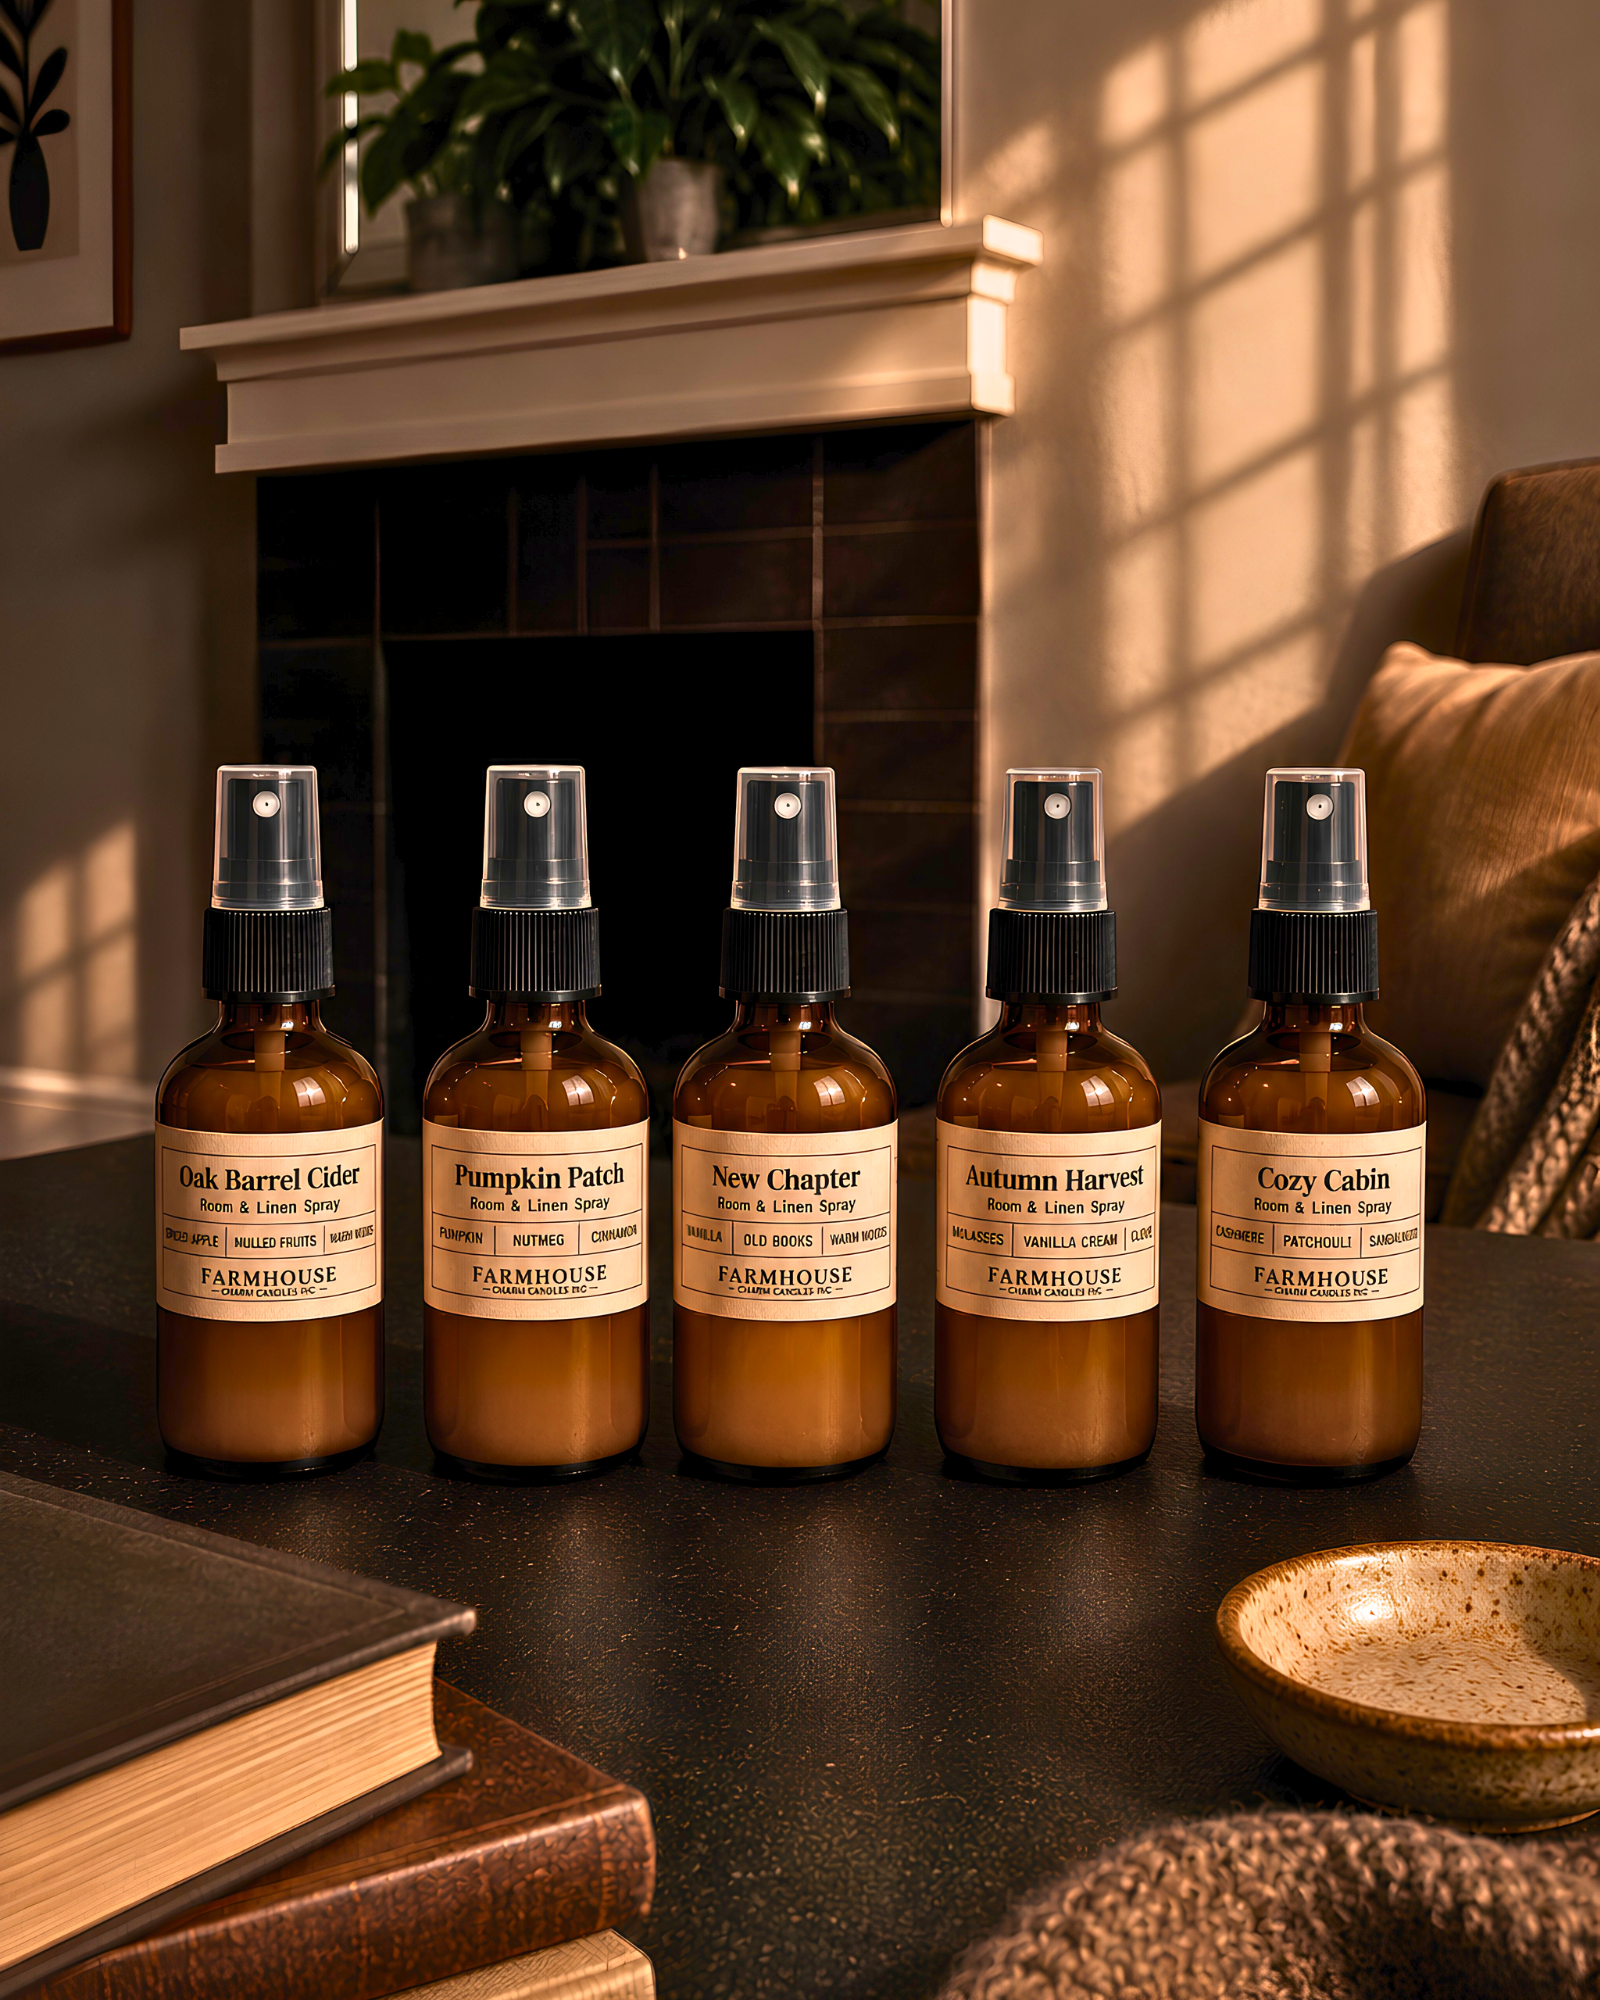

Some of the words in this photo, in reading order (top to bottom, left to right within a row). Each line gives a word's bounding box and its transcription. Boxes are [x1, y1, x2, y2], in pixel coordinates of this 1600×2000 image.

[180, 1165, 219, 1190] Oak
[225, 1168, 301, 1191] Barrel
[308, 1165, 360, 1189] Cider
[455, 1164, 561, 1195] Pumpkin
[568, 1162, 624, 1188] Patch
[713, 1165, 760, 1189] New
[767, 1169, 860, 1195] Chapter
[966, 1165, 1058, 1191] Autumn
[1065, 1165, 1143, 1191] Harvest
[1257, 1167, 1317, 1197] Cozy
[1324, 1168, 1390, 1192] Cabin
[200, 1198, 233, 1213] Room
[240, 1201, 249, 1213] &
[257, 1201, 296, 1214] Linen
[304, 1199, 340, 1214] Spray
[470, 1196, 504, 1211] Room
[511, 1199, 520, 1211] &
[528, 1199, 568, 1212] Linen
[575, 1198, 610, 1213] Spray
[718, 1196, 750, 1211] Room
[756, 1200, 765, 1212] &
[773, 1200, 812, 1213] Linen
[820, 1200, 856, 1215] Spray
[987, 1197, 1021, 1212] Room
[1027, 1201, 1037, 1213] &
[1045, 1201, 1084, 1214] Linen
[1091, 1201, 1124, 1216] Spray
[1254, 1197, 1289, 1213] Room
[1295, 1201, 1304, 1214] &
[1312, 1201, 1351, 1214] Linen
[1358, 1201, 1391, 1217] Spray
[280, 1235, 316, 1248] FRUITS
[513, 1234, 564, 1246] NUTMEG
[744, 1234, 767, 1246] OLD
[773, 1235, 812, 1247] BOOKS
[1024, 1236, 1076, 1248] VANILLA
[1284, 1235, 1351, 1248] PATCHOULI
[202, 1267, 336, 1286] FARMHOUSE
[473, 1265, 606, 1286] FARMHOUSE
[718, 1266, 852, 1285] FARMHOUSE
[988, 1266, 1121, 1286] FARMHOUSE
[1255, 1266, 1388, 1286] FARMHOUSE
